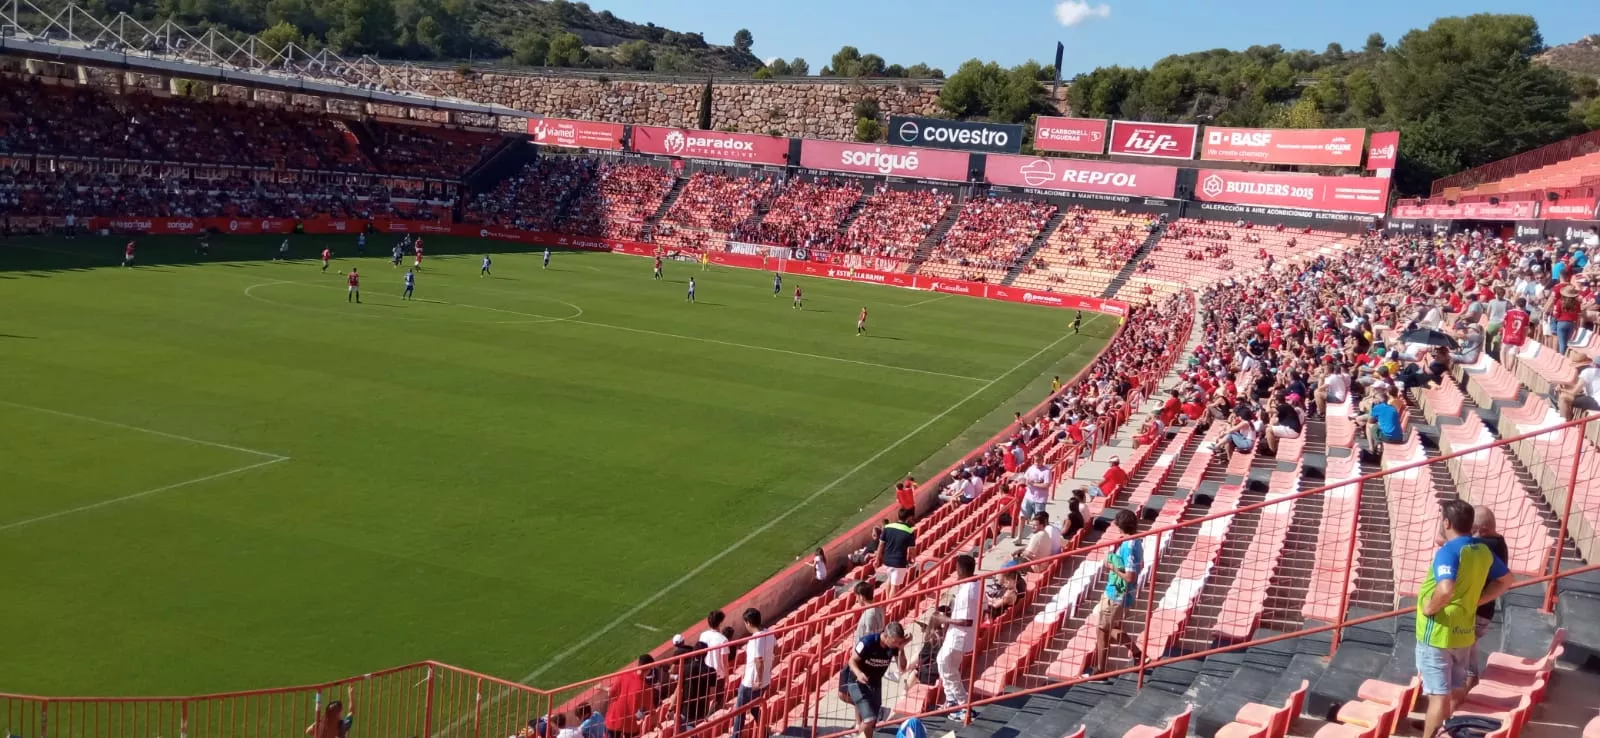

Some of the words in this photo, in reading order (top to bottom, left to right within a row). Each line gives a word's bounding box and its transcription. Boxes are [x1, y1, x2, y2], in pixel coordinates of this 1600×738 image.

[547, 127, 575, 138] viamed
[923, 127, 1008, 146] covestro
[1051, 128, 1088, 136] CARBONELL
[1230, 132, 1272, 147] BASF
[686, 137, 754, 151] paradox
[1124, 131, 1179, 154] hife
[685, 148, 755, 158] INTERACTIVE
[841, 147, 919, 174] sorigué
[1239, 150, 1269, 158] chemistry
[1062, 169, 1137, 188] REPSOL
[1024, 188, 1071, 197] INSTALACIONES
[1078, 193, 1130, 203] MANTENIMIENTO
[1226, 181, 1290, 196] BUILDERS
[1291, 186, 1314, 200] 2015
[1266, 208, 1313, 217] ACONDICIONADO
[572, 239, 598, 248] Augusta
[1511, 319, 1522, 334] 9
